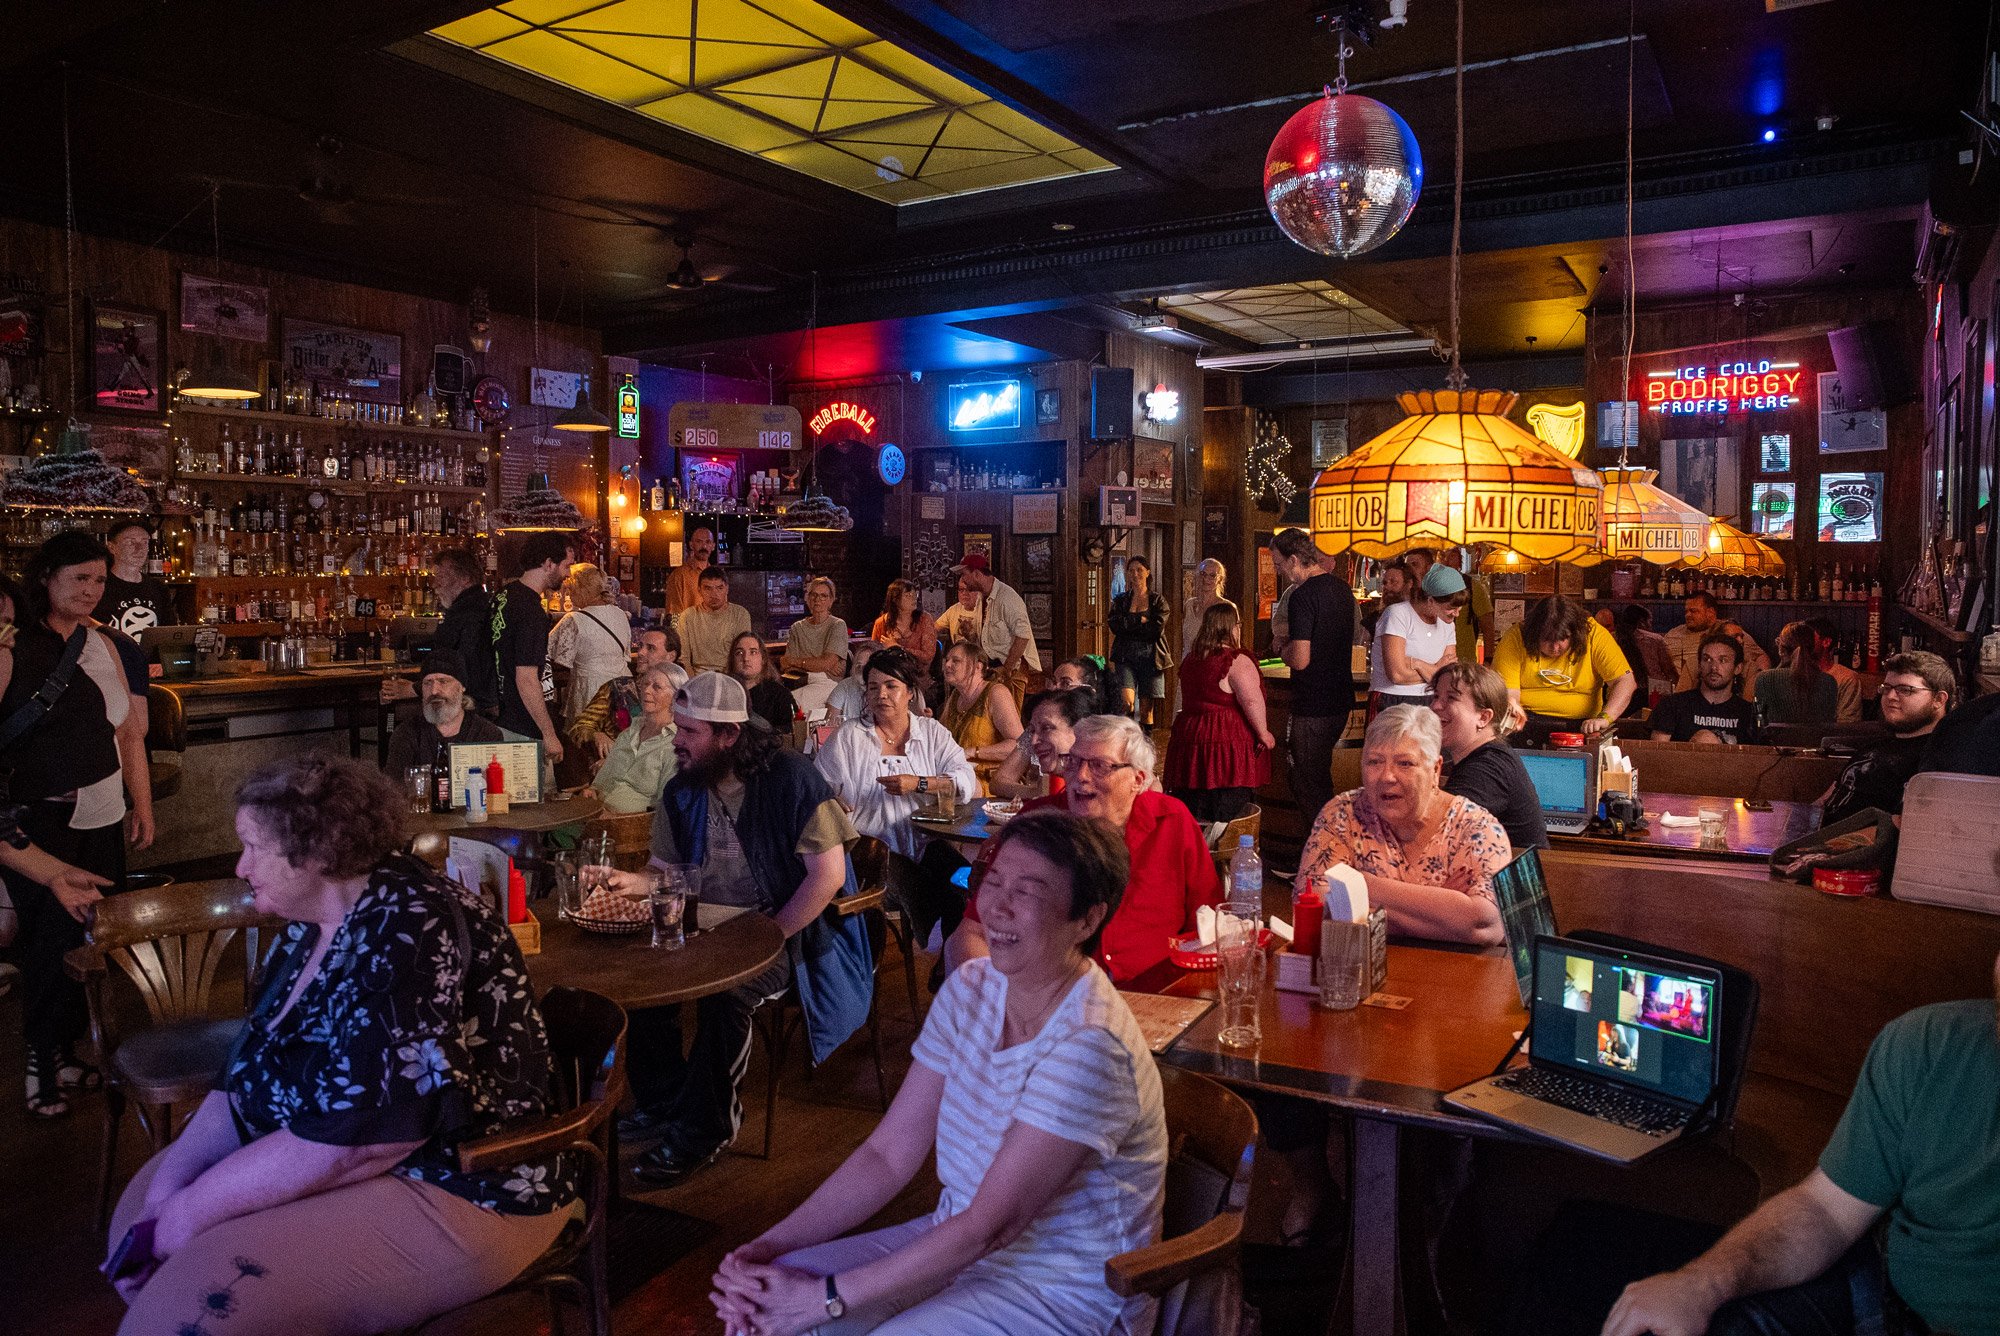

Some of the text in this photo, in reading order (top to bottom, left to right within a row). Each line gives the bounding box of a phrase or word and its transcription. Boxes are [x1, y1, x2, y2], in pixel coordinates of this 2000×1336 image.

[315, 334, 373, 353] CARLTON
[293, 346, 389, 378] Bitter Ale
[1676, 360, 1771, 380] ICE COLD
[1648, 372, 1801, 402] BODRIGGY
[1660, 395, 1789, 414] FROFFS HERE
[809, 402, 875, 435] FIREBALL
[686, 430, 718, 446] 250
[761, 432, 792, 448] 142
[1827, 485, 1851, 500] ROCK
[1472, 493, 1598, 532] MICHELOB
[1618, 527, 1699, 549] MICHELOB
[357, 601, 374, 615] 46
[1867, 611, 1882, 657] CAMPARI
[1693, 714, 1739, 729] HARMONY
